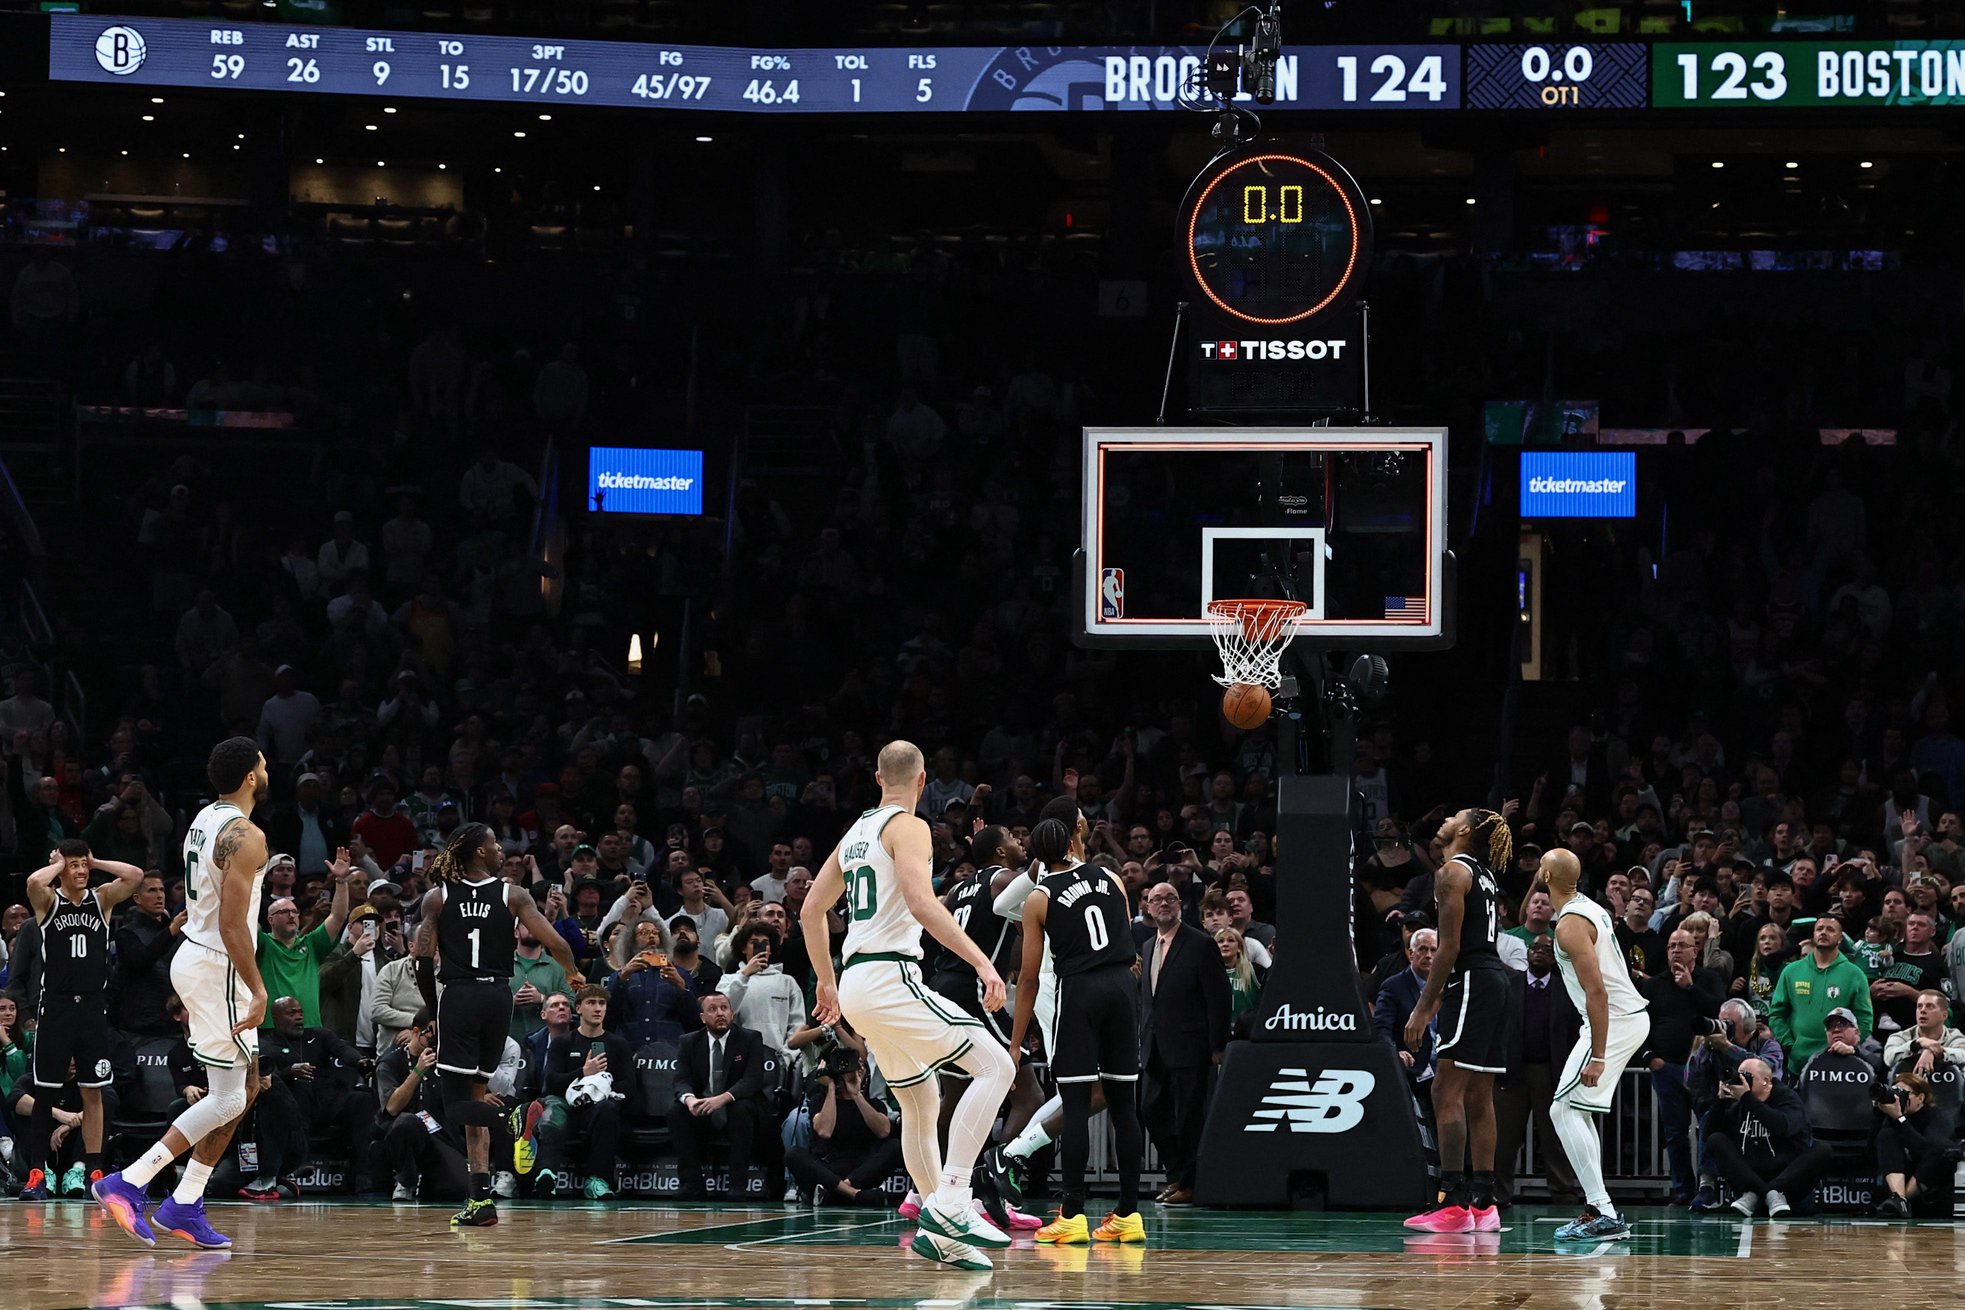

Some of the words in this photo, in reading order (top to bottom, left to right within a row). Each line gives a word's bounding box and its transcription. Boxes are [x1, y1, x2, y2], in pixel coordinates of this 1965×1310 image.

[211, 30, 243, 45] REB
[286, 34, 319, 49] AST
[366, 38, 394, 52] STL
[439, 41, 463, 55] TO
[532, 45, 564, 60] 3PT
[660, 51, 683, 65] FG
[751, 55, 791, 70] FG%
[835, 55, 868, 70] TOL
[909, 55, 936, 69] FLS
[1521, 46, 1593, 82] 0.0
[210, 54, 245, 79] 59
[287, 58, 320, 83] 26
[373, 61, 390, 86] 9
[440, 64, 469, 89] 15
[1338, 55, 1447, 101] 124
[1677, 52, 1787, 100] 123
[1818, 50, 1965, 97] BOSTON
[510, 67, 589, 95] 17/50
[631, 73, 712, 99] 45/97
[1106, 56, 1297, 101] BROOLN
[743, 79, 800, 104] 46.4
[851, 79, 861, 103] 1
[916, 78, 932, 103] 5
[1541, 87, 1579, 104] OT1
[1243, 185, 1303, 223] 0.0
[1240, 340, 1346, 360] TISSOT
[597, 471, 694, 492] ticketmaster
[1529, 475, 1626, 495] ticketmaster
[1056, 879, 1092, 909] BROWN
[1095, 878, 1111, 897] JR.
[459, 901, 491, 919] ELLIS
[53, 914, 101, 932] BROOKLYN
[1084, 904, 1109, 952] 0
[69, 933, 87, 959] 10
[467, 928, 481, 969] 1
[1264, 1003, 1357, 1031] Amica
[136, 1055, 169, 1066] PIM
[636, 1058, 678, 1071] PIMC
[1809, 1070, 1869, 1084] PIMCO
[286, 1168, 344, 1187] etBlue
[616, 1171, 680, 1194] jetBlue
[1822, 1185, 1873, 1205] tBlue
